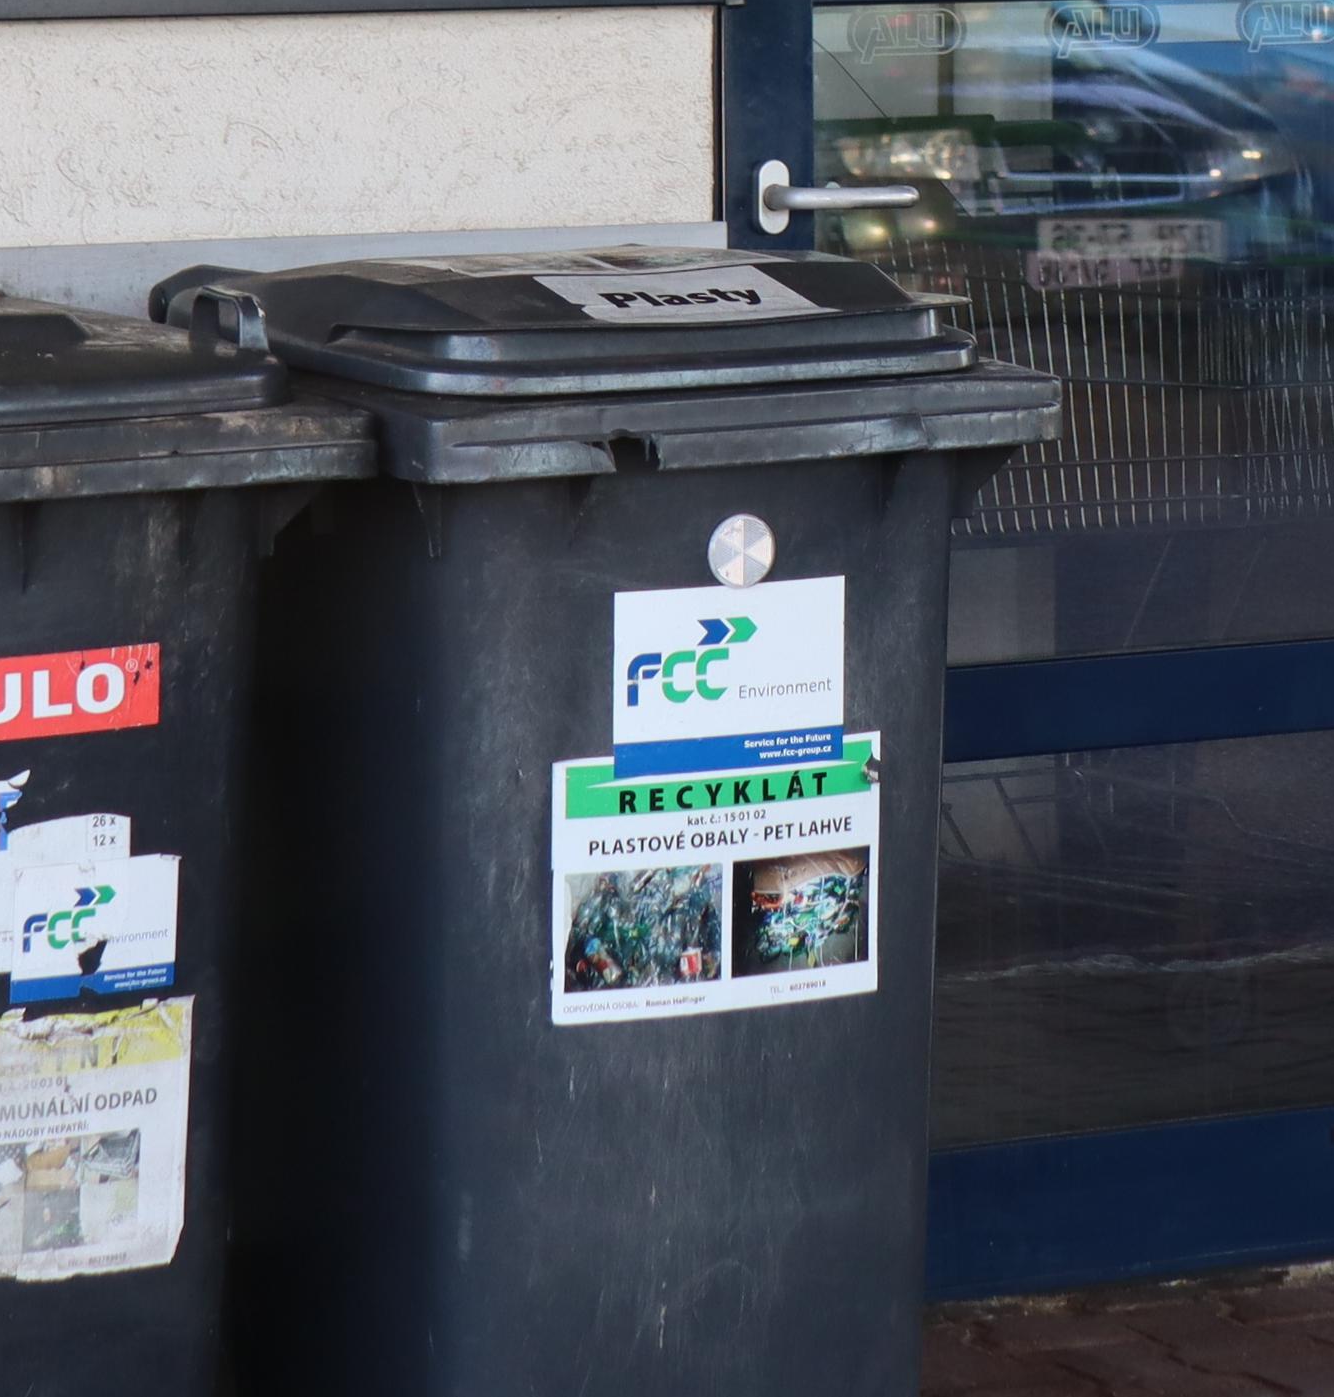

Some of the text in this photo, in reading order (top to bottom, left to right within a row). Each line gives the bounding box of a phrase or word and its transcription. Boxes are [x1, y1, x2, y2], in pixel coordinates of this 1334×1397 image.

[598, 287, 762, 309] Plasty
[626, 647, 730, 707] FCC
[738, 677, 833, 699] Environment
[744, 732, 832, 749] Service for the Future
[759, 744, 833, 759] www.fcc-group.cz
[619, 771, 828, 815] RECYKLÁT
[92, 815, 106, 827] 26
[687, 808, 767, 826] kat. č.: 15 01 02
[93, 835, 116, 846] 12 x
[588, 815, 853, 857] PLASTOVÉ OBALY PET LAHVE
[22, 907, 97, 953] FCC
[645, 997, 672, 1008] Roman
[94, 1087, 158, 1112] ODPAD
[3, 1125, 45, 1140] NÁDOBY
